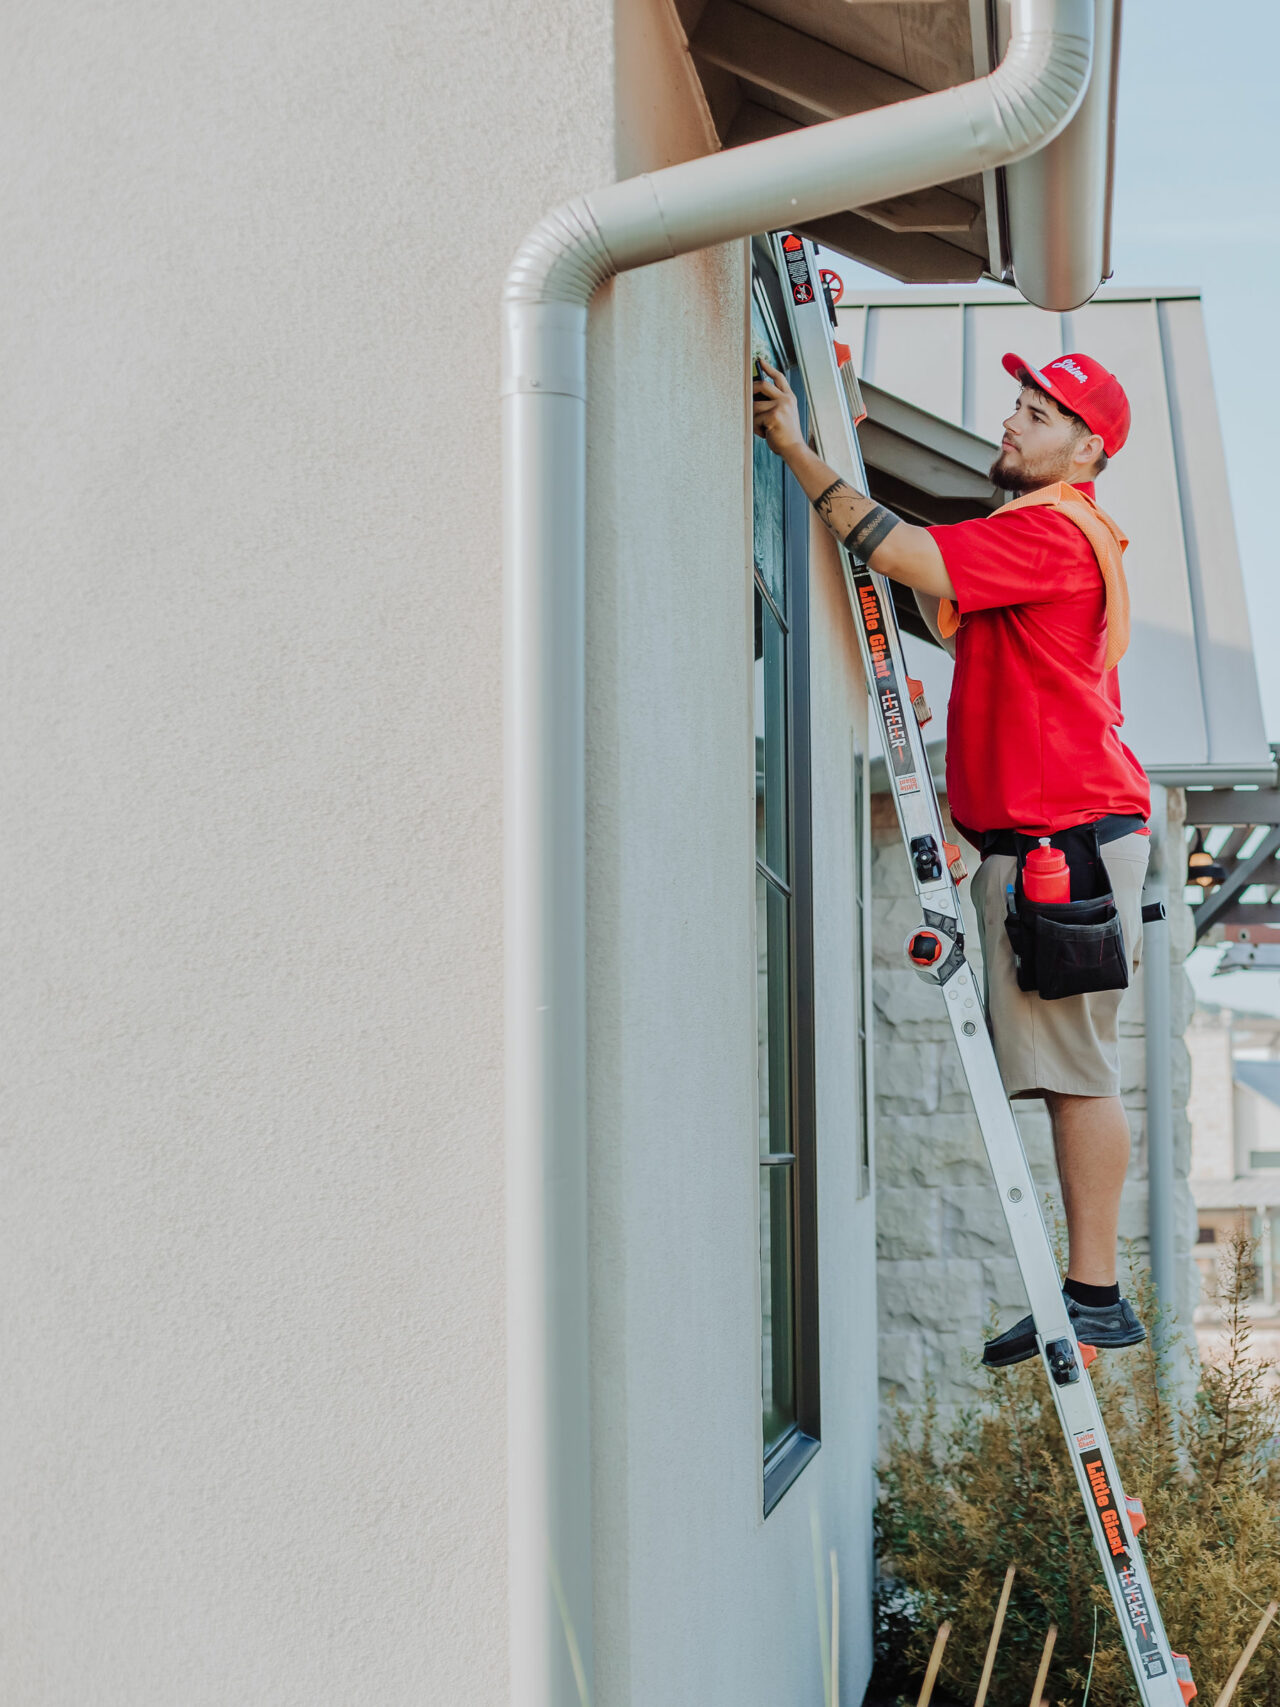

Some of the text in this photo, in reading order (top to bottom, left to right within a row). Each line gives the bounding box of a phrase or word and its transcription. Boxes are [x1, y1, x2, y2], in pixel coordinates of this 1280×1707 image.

[858, 585, 880, 631] Little
[869, 633, 891, 679] Giant
[881, 693, 907, 749] LEVELER
[1085, 1460, 1125, 1556] Little Giant
